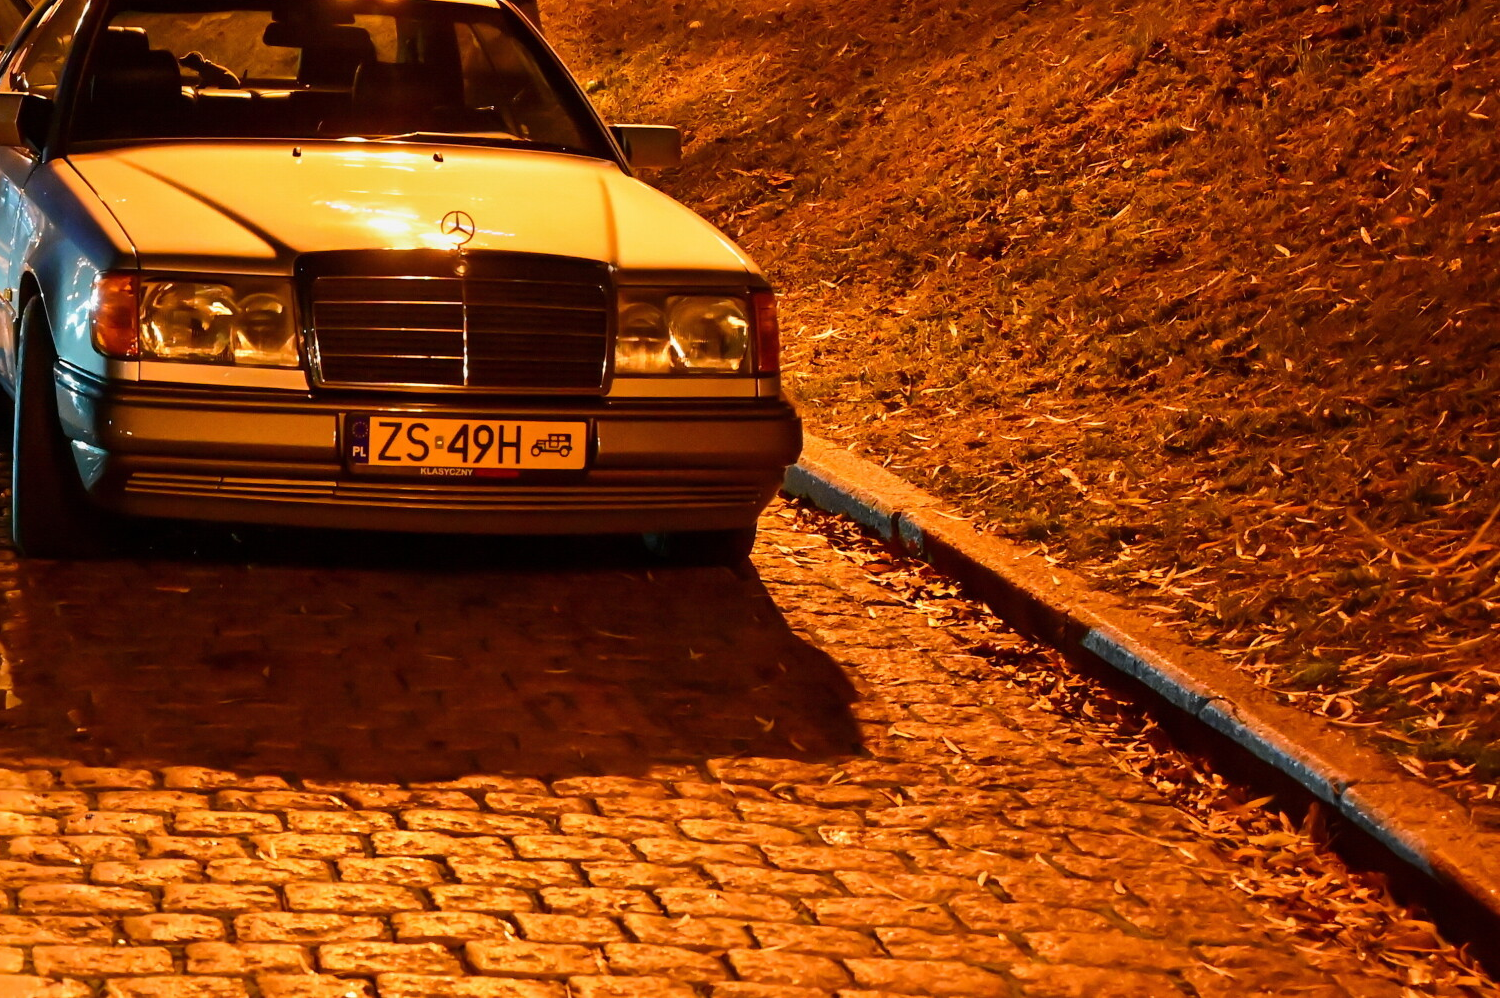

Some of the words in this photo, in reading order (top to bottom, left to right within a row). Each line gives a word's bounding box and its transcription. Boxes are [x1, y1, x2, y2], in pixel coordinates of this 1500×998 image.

[378, 421, 430, 462] ZS
[447, 424, 522, 464] 49H
[352, 446, 367, 457] PL
[420, 467, 473, 476] KLASYCZNY
